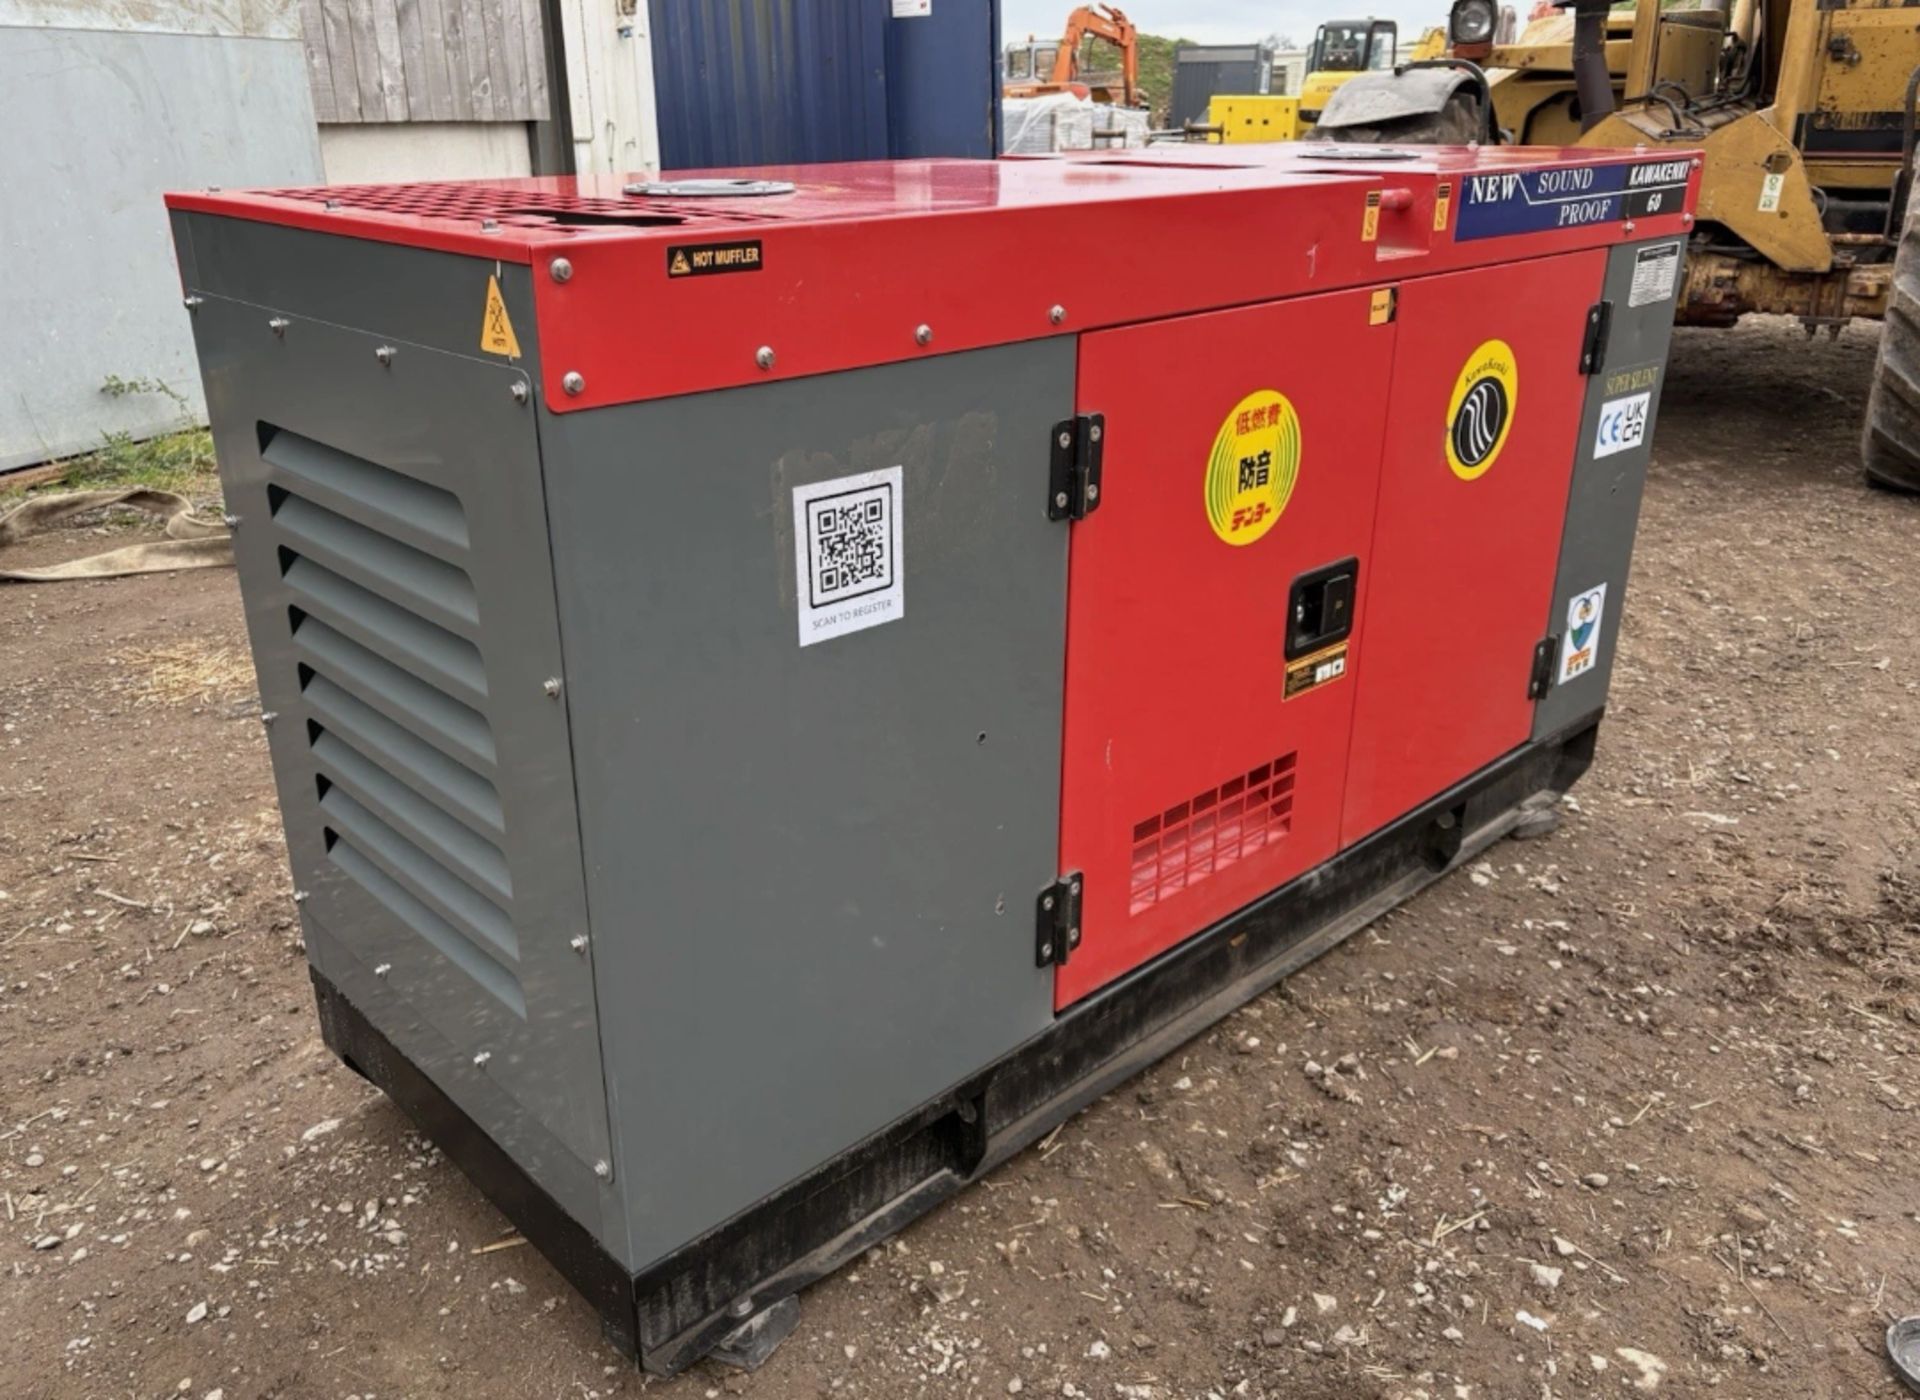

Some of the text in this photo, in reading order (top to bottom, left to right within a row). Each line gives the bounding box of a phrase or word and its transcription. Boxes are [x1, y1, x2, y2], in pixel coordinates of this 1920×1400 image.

[1469, 173, 1519, 205] NEW
[1537, 167, 1594, 194] SOUND
[1558, 199, 1612, 226] PROOF
[693, 247, 759, 267] HOT MUFFLER
[1627, 401, 1645, 421] UK
[1622, 421, 1642, 442] CA
[1238, 449, 1271, 494] 防音
[812, 600, 892, 630] SCAN TO REGISTER
